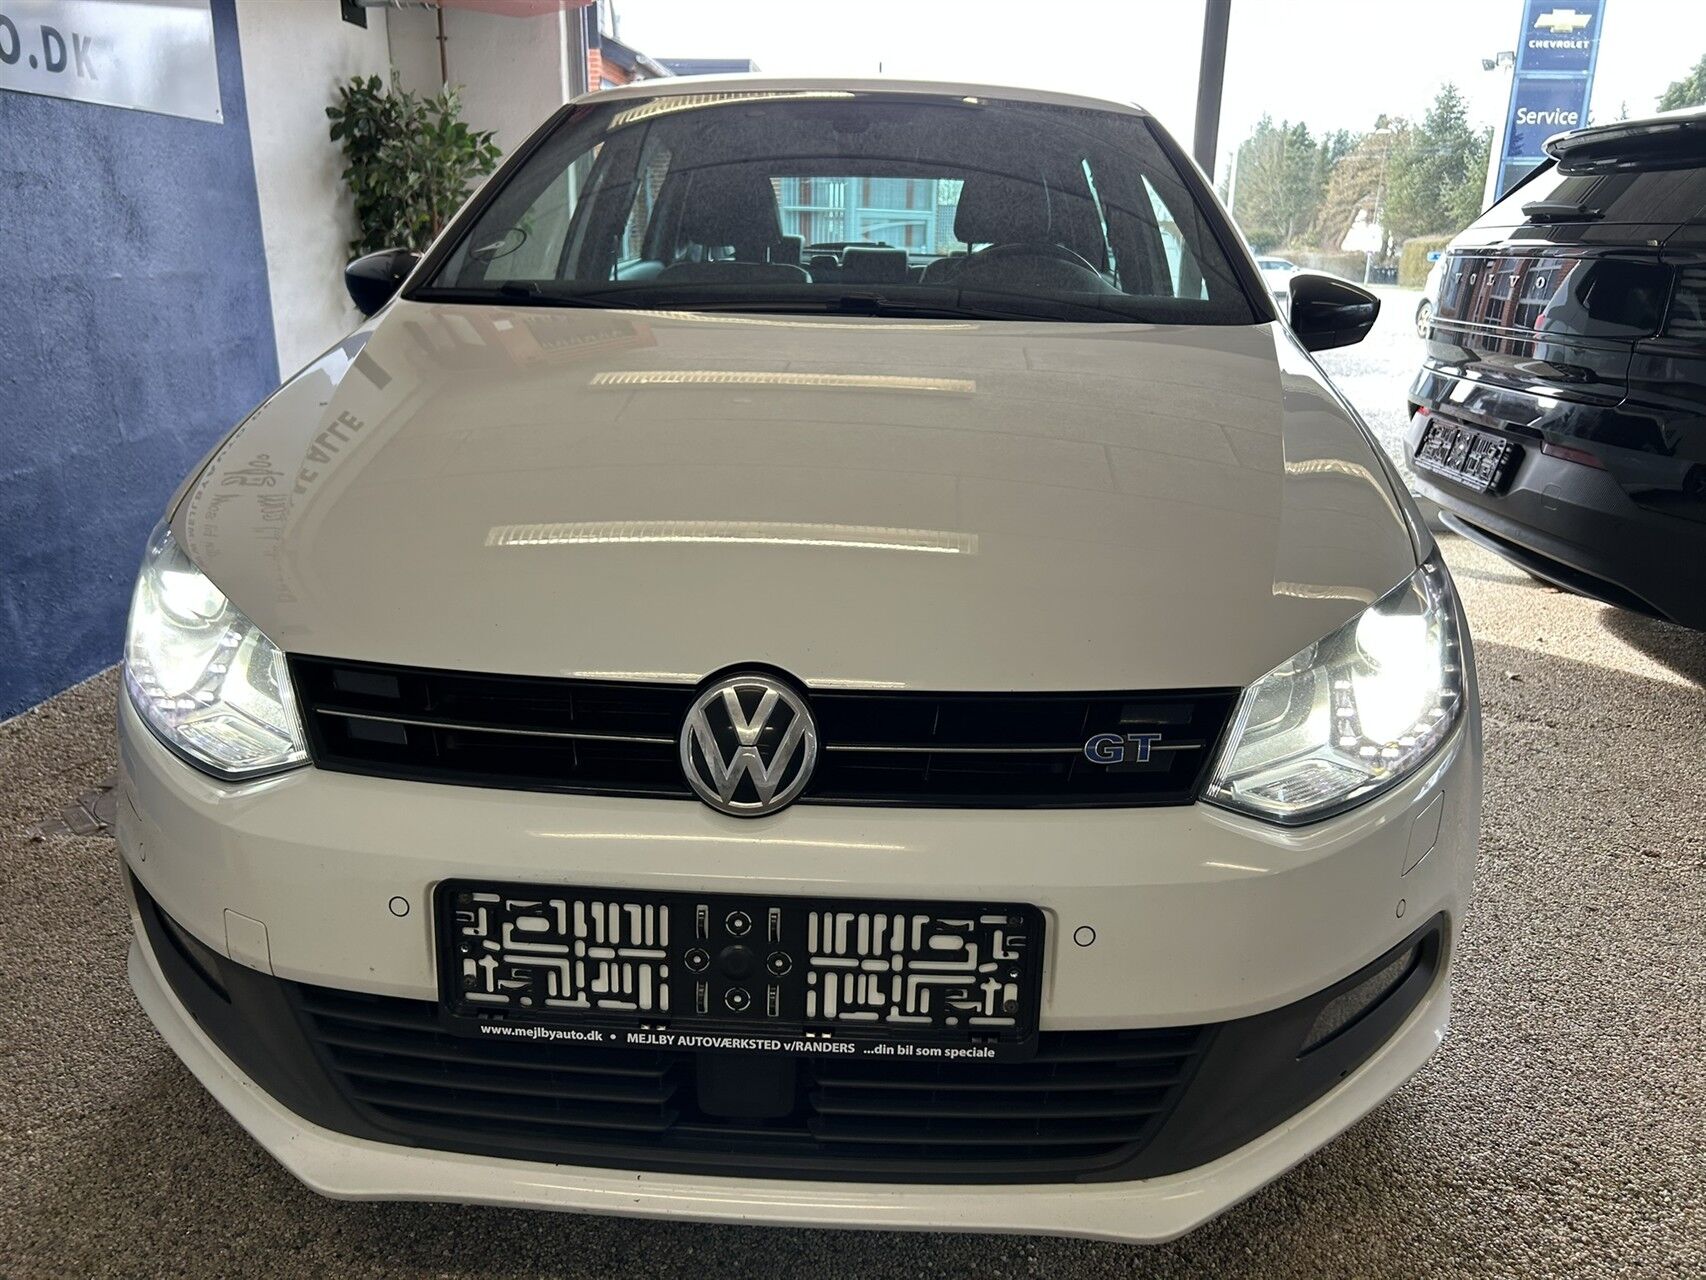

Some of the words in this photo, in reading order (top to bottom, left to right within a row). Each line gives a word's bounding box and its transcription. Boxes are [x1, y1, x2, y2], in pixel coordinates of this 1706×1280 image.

[1528, 39, 1590, 49] CHEVROLET
[1516, 107, 1579, 125] Service
[1455, 272, 1546, 289] VOLVO
[1084, 732, 1162, 765] GT
[480, 1024, 603, 1042] www.mejlbyauto.dk
[627, 1032, 675, 1046] MEJLBY
[677, 1035, 782, 1051] AUTOVÆRKSTED
[783, 1041, 856, 1054] v/RANDERS
[897, 1044, 914, 1056] bil
[916, 1046, 942, 1057] som
[944, 1046, 996, 1059] speciale
